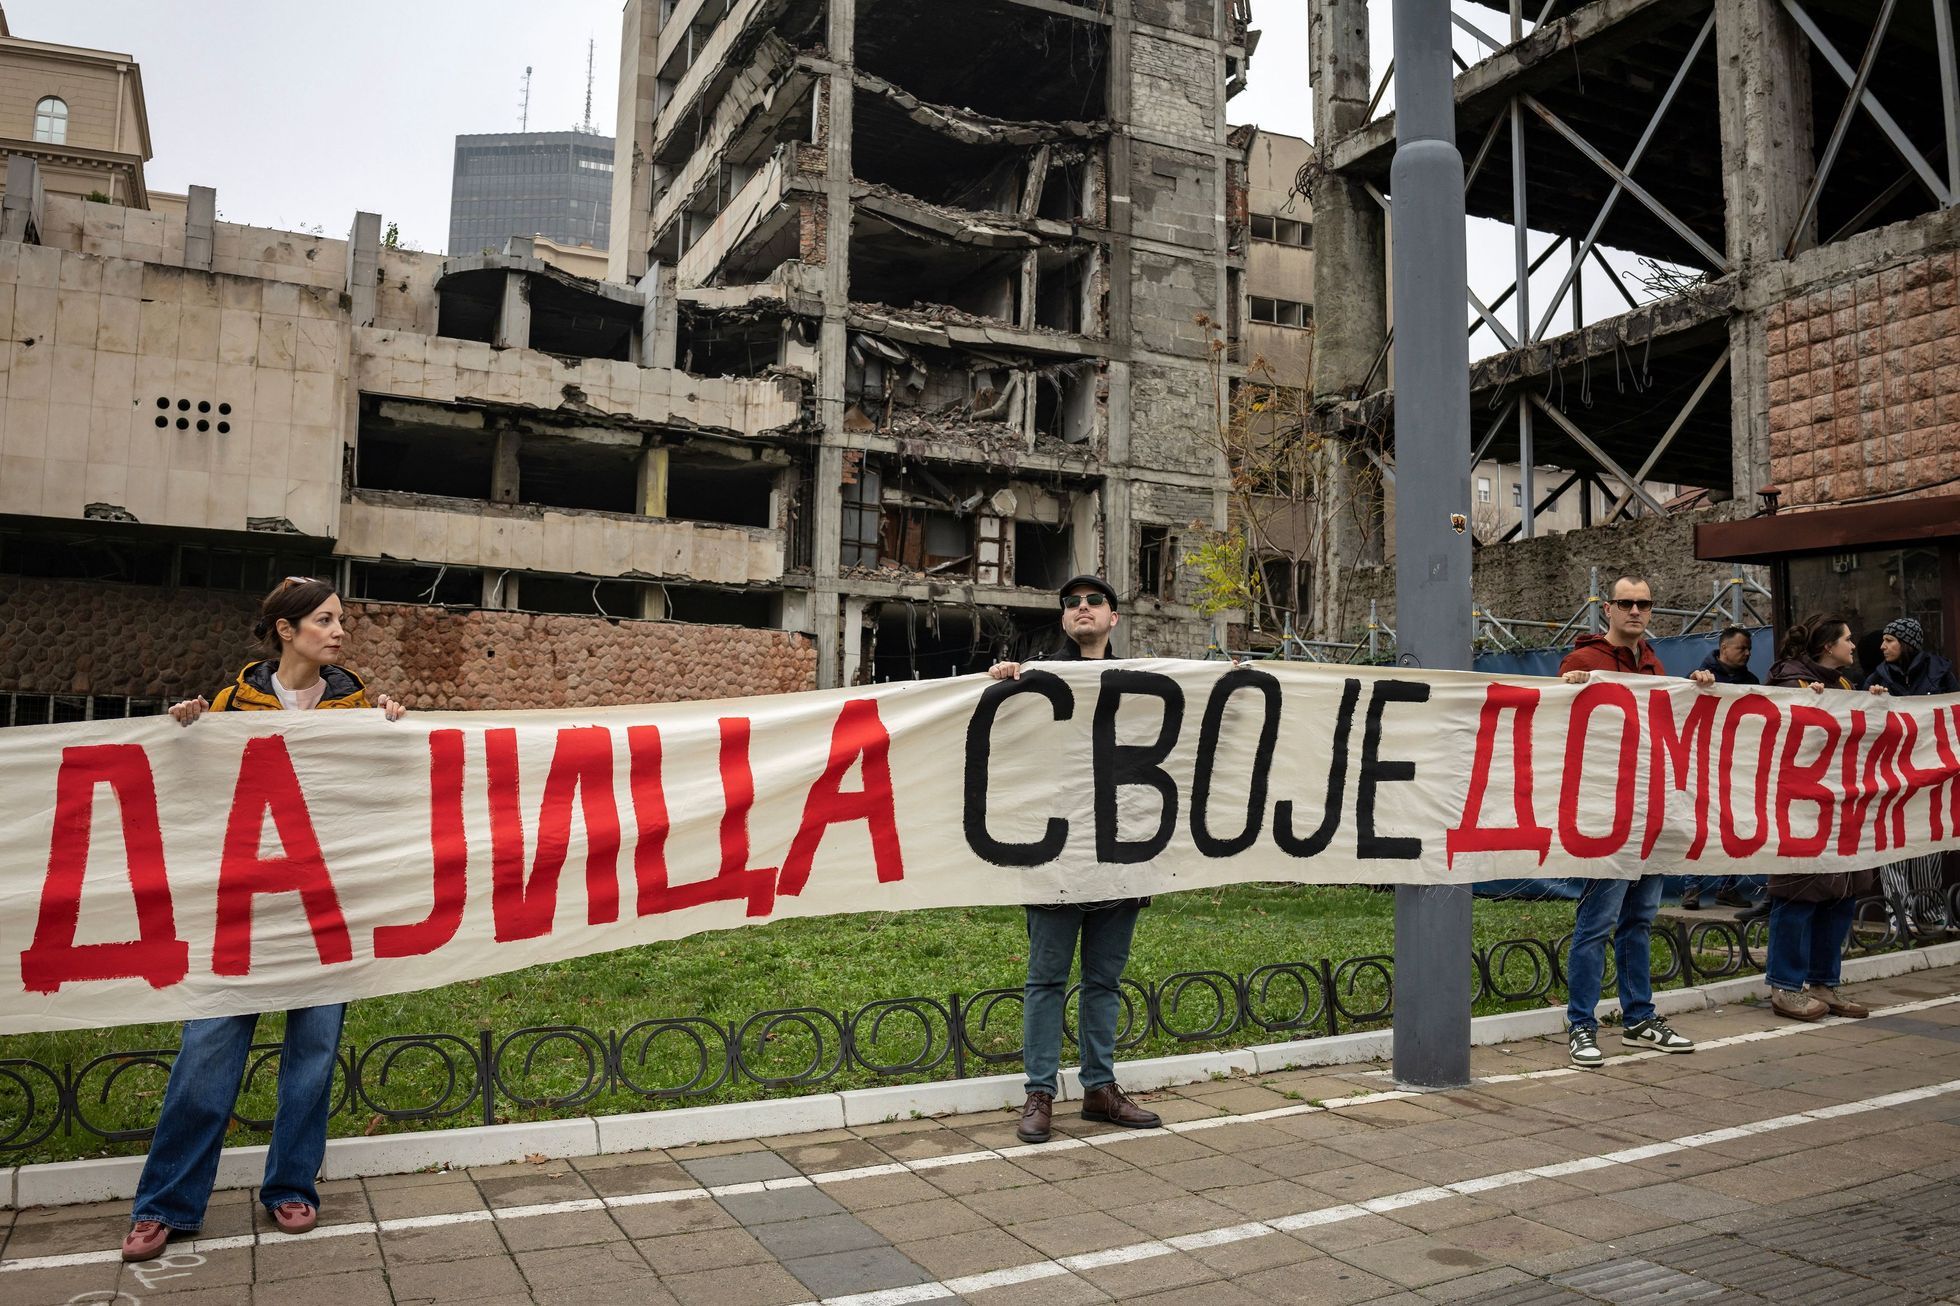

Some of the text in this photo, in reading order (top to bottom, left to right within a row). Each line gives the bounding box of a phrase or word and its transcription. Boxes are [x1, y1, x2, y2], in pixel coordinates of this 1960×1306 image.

[21, 668, 1960, 995] ДАЈИЦА СВОЈЕ ДОМОВИН
